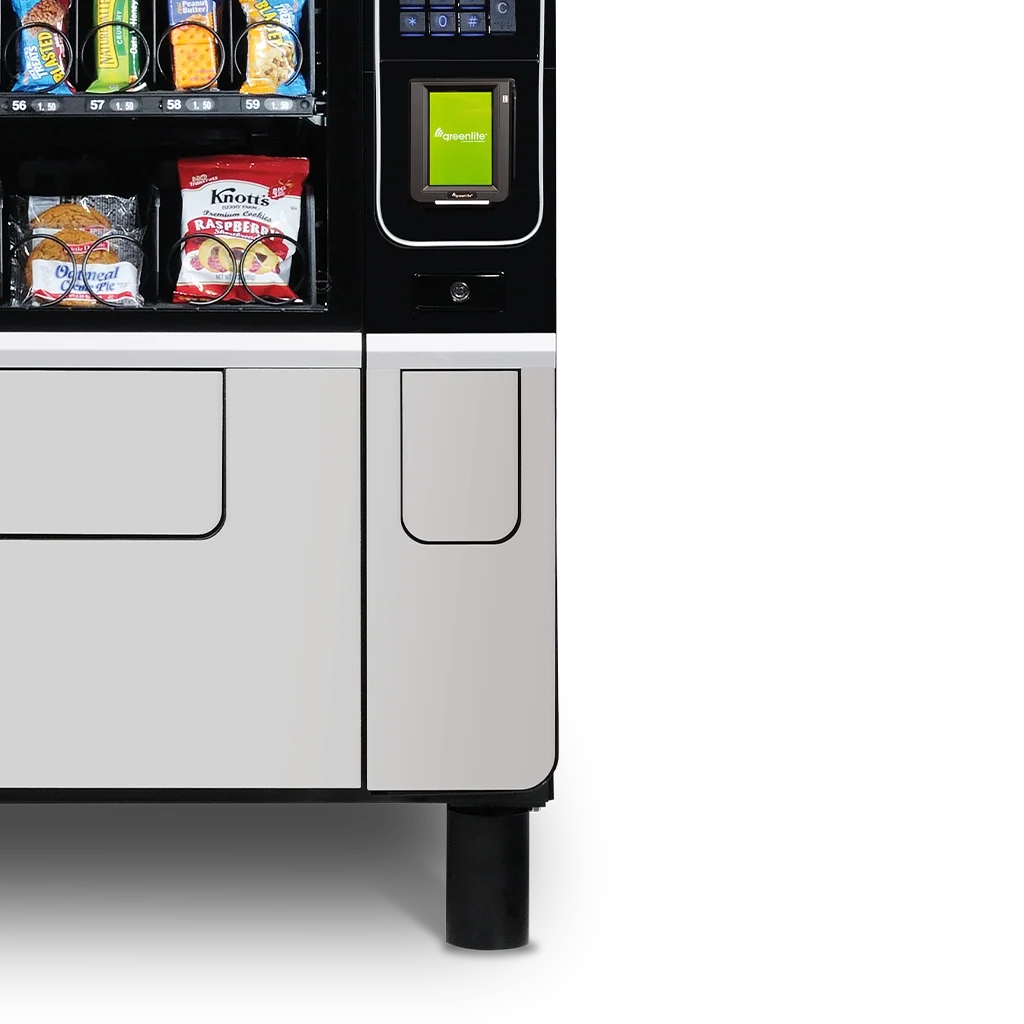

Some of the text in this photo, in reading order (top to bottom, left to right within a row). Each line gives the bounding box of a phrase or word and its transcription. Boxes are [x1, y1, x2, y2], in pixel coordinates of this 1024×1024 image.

[182, 0, 208, 8] Peanut
[497, 2, 508, 14] C
[182, 6, 207, 14] Butter
[438, 15, 447, 28] 0
[129, 0, 139, 55] Oats Honey
[37, 31, 66, 84] BLASTED
[12, 100, 27, 111] 56
[90, 100, 105, 110] 57
[167, 99, 182, 110] 58
[245, 99, 261, 109] 59
[442, 131, 486, 142] greenlite
[210, 188, 270, 207] Knott's
[203, 210, 272, 223] Premium Cookies
[55, 264, 120, 282] Oatmeal
[96, 281, 116, 292] Pie
